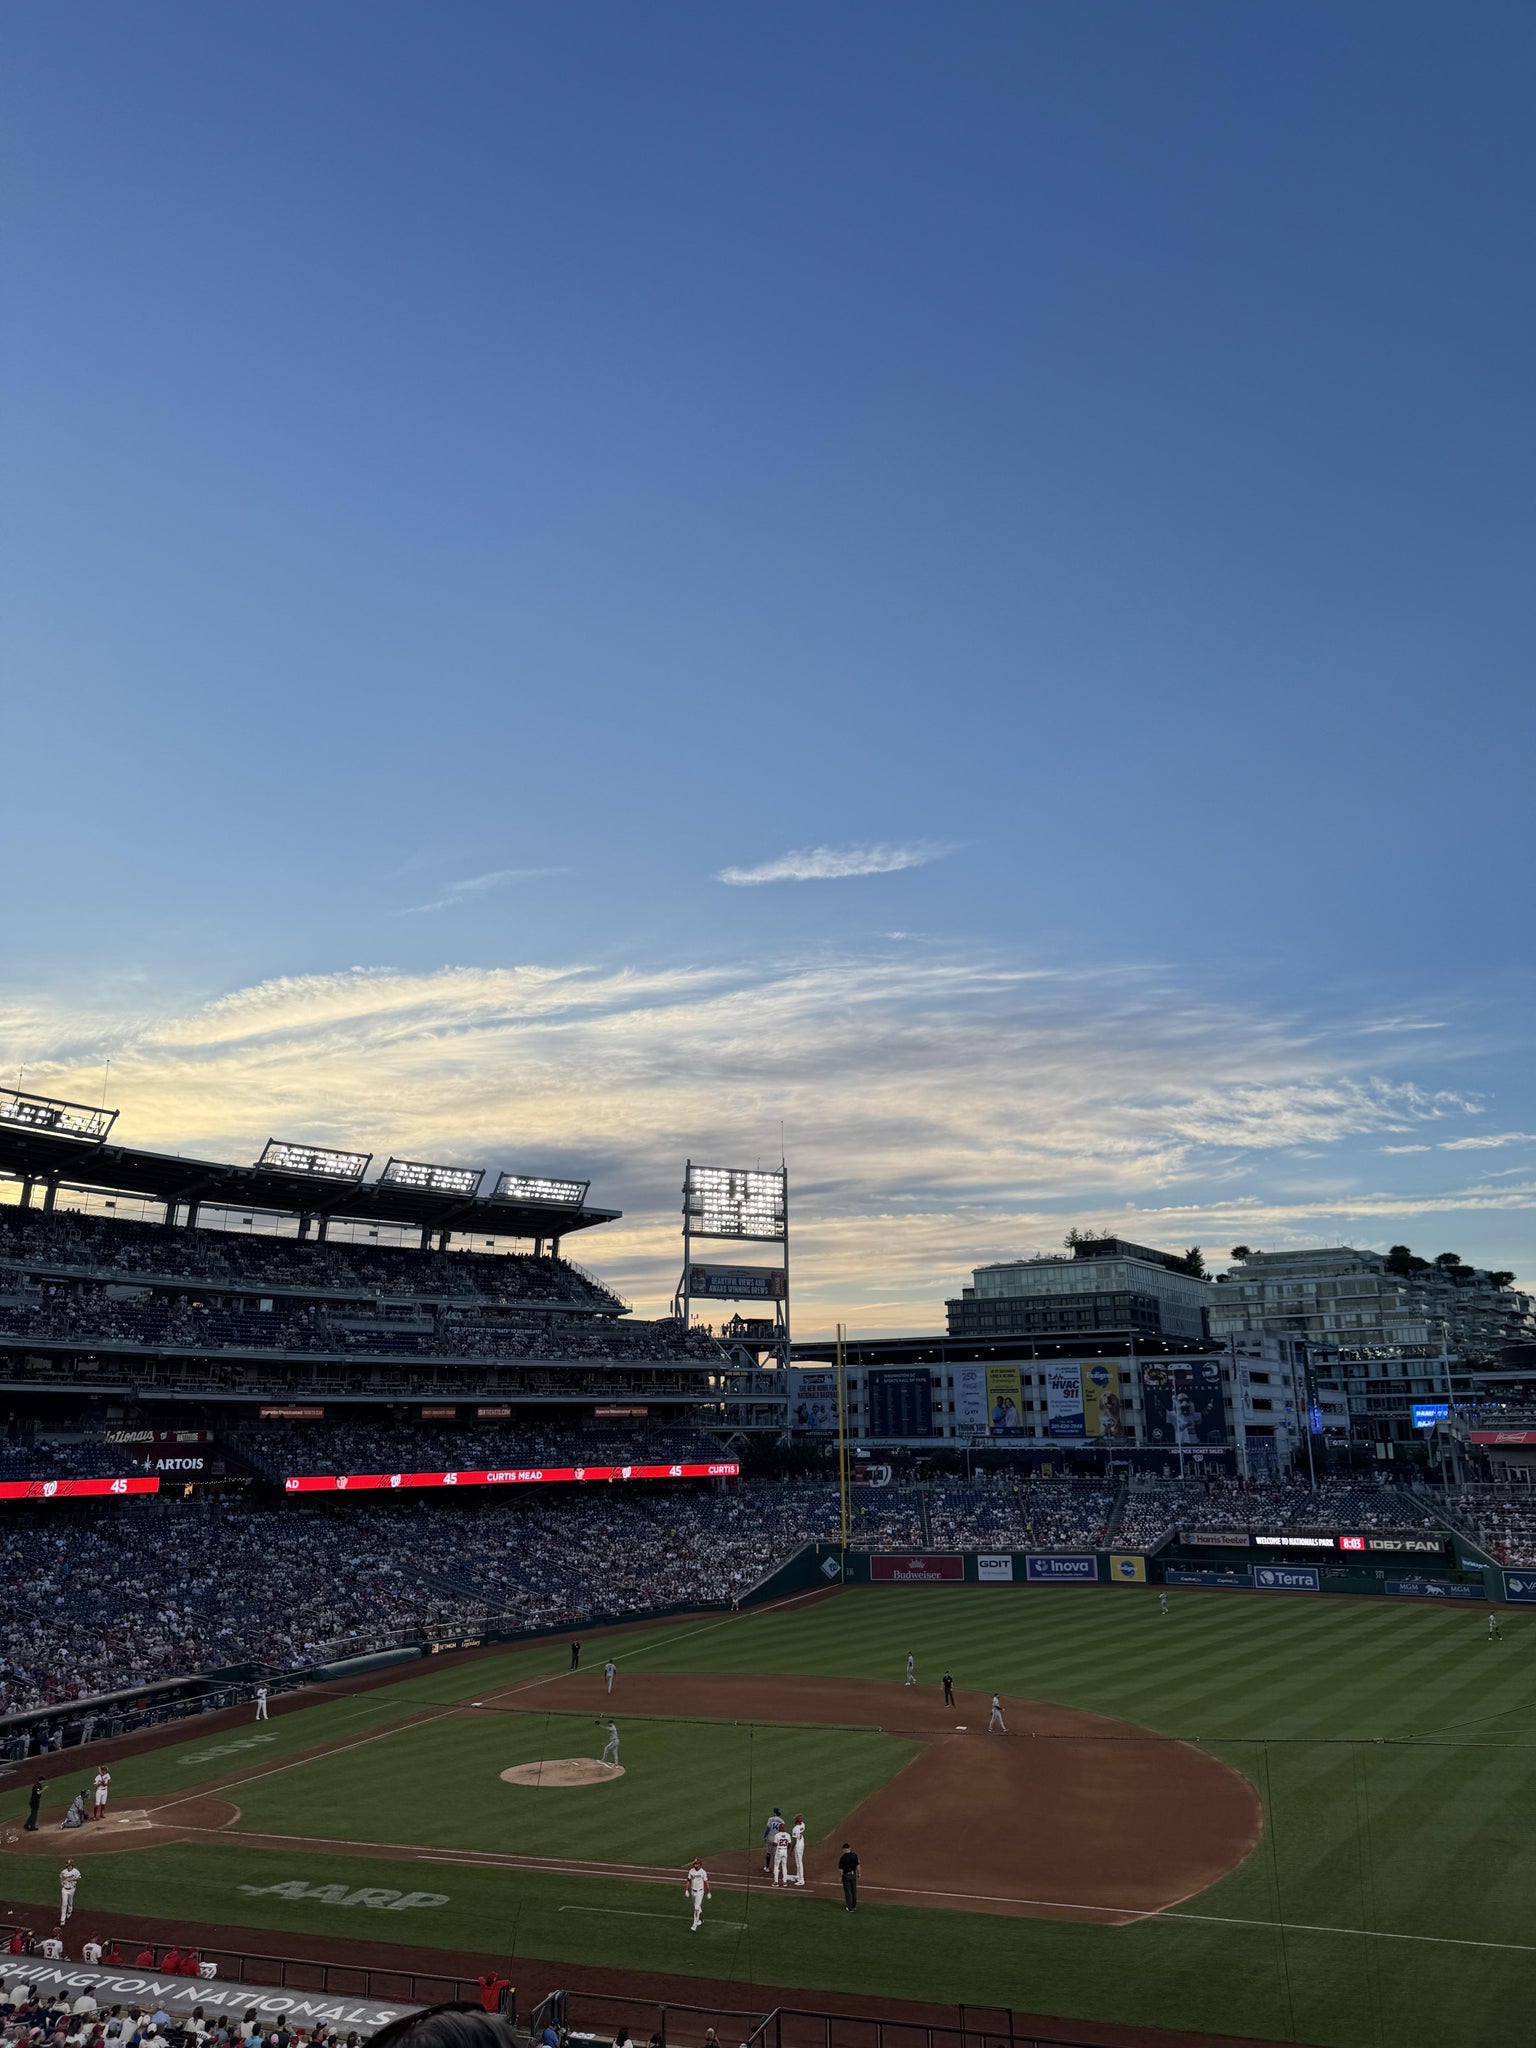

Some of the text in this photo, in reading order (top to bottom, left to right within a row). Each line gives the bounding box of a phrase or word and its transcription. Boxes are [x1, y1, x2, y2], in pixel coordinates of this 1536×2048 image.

[738, 1278, 754, 1287] VIEWS
[1052, 1380, 1080, 1389] HVAC
[1063, 1389, 1079, 1398] 911
[155, 1458, 204, 1471] ARTOIS
[669, 1465, 682, 1477] 45
[708, 1465, 735, 1475] CURTIS
[442, 1472, 458, 1484] 45
[487, 1472, 516, 1482] CURTIS
[518, 1471, 543, 1480] MEAD
[110, 1479, 128, 1493] 45
[1256, 1536, 1335, 1548] WELCOME TO NATIONALS PARK
[1343, 1539, 1361, 1549] 8:03
[1405, 1541, 1440, 1551] FAN
[980, 1560, 1010, 1568] GDIT
[1051, 1560, 1089, 1572] Inova
[893, 1569, 941, 1579] Budweiser
[1275, 1572, 1314, 1586] Terra
[1399, 1583, 1419, 1591] MGM
[779, 1838, 788, 1847] 23
[236, 1880, 451, 1910] AARP
[47, 1948, 53, 1957] 3
[86, 1951, 91, 1960] 9
[172, 1986, 398, 2026] NATIONALS
